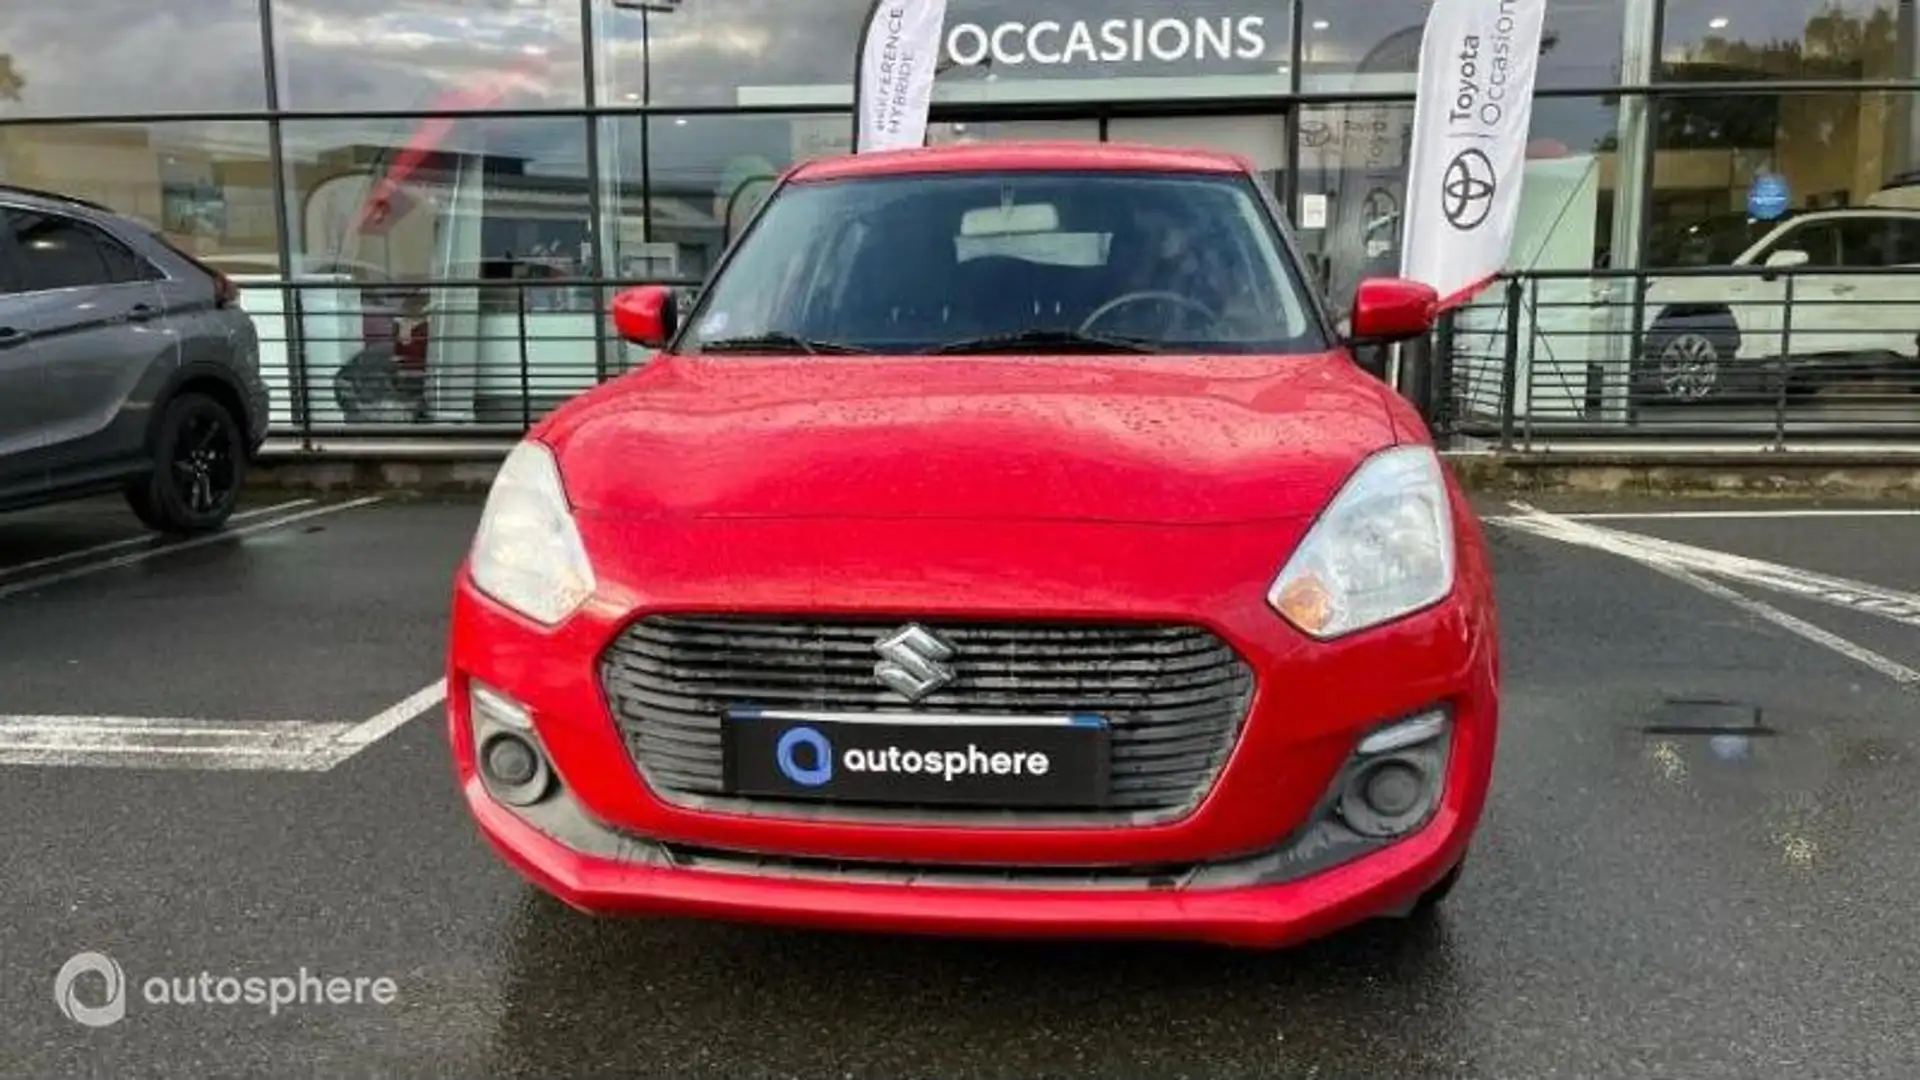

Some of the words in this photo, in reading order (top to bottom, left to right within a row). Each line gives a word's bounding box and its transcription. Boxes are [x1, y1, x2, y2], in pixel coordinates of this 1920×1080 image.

[947, 16, 1265, 65] OCCASIONS
[1448, 35, 1480, 123] Toyota
[843, 743, 1049, 781] autosphere
